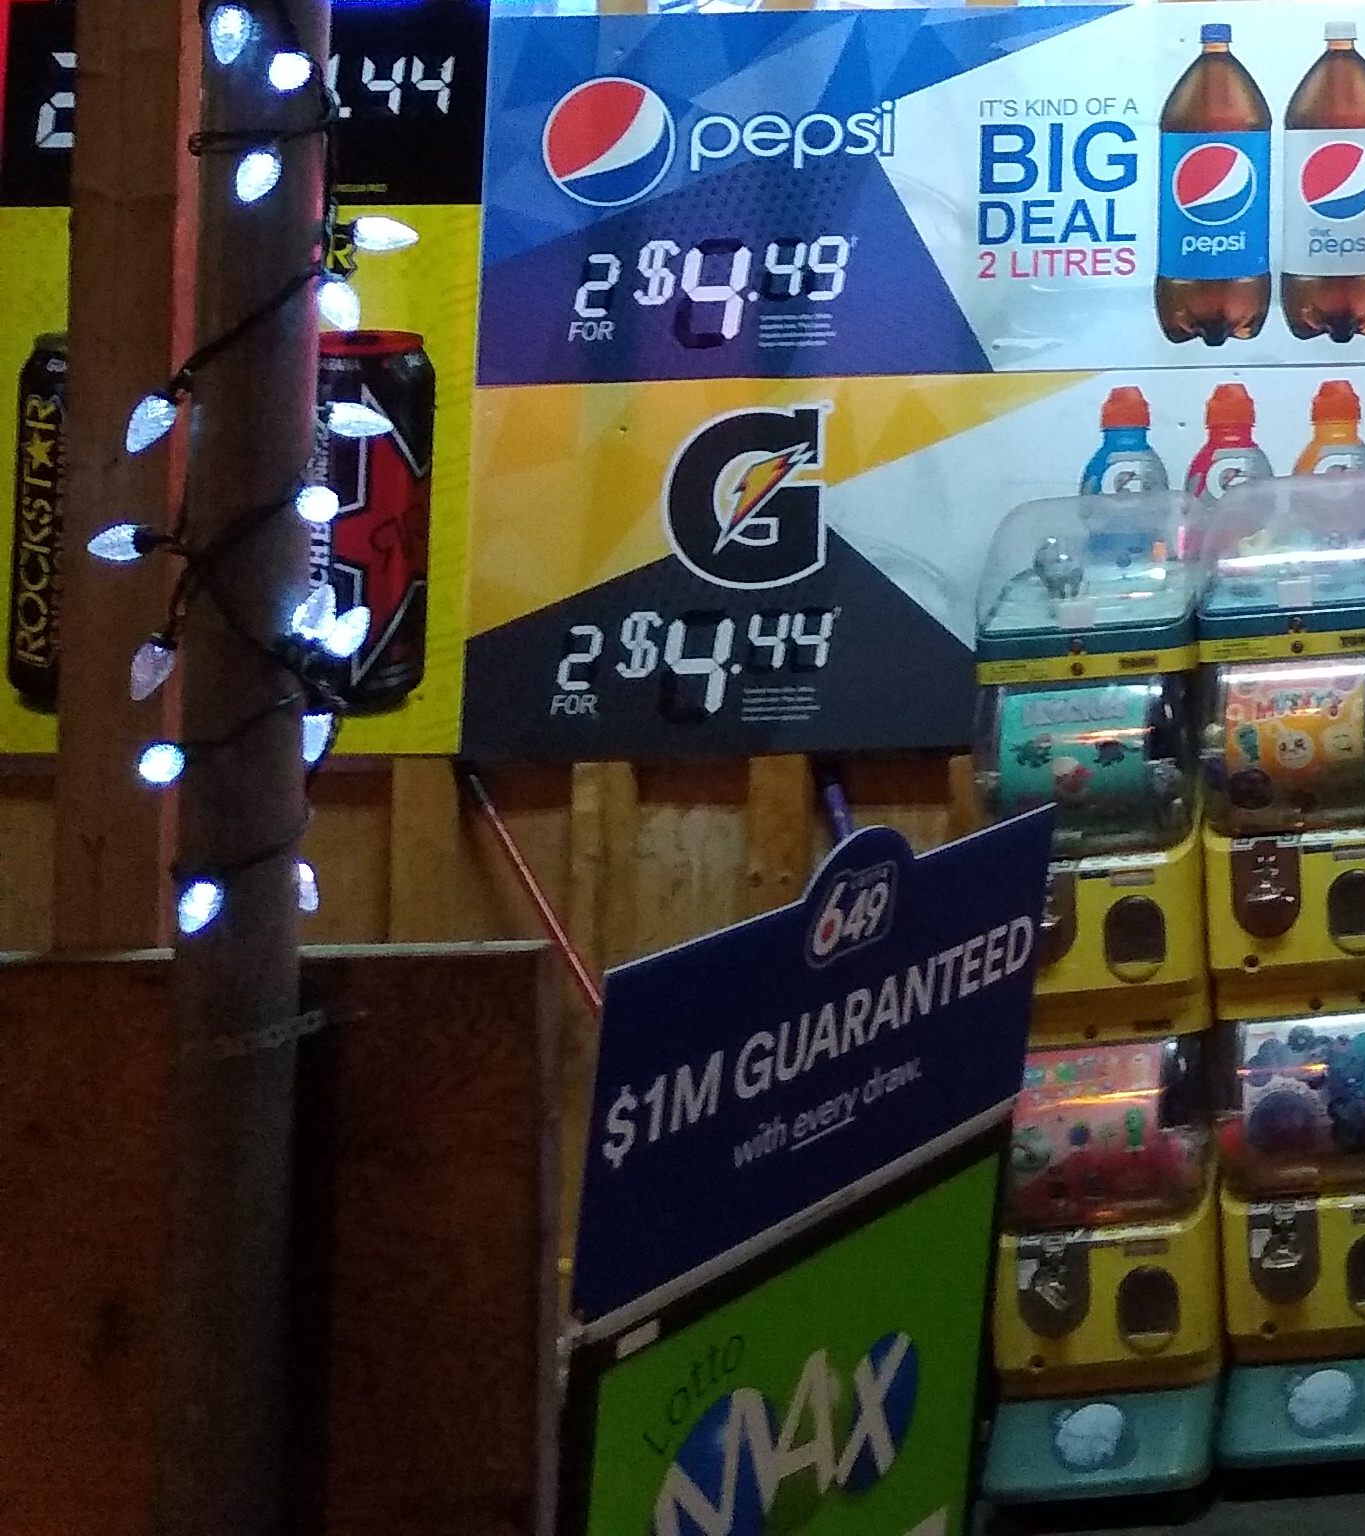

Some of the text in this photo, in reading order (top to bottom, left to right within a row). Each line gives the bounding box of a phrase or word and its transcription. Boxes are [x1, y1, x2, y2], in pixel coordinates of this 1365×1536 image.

[689, 100, 895, 172] pepsi
[978, 96, 1140, 119] IT'S KIND OF A
[978, 120, 1139, 195] BIG
[977, 198, 1137, 245] DEAL
[1181, 229, 1247, 256] pepsi
[573, 252, 622, 318] 2
[977, 247, 1137, 279] 2 LITRES
[567, 320, 615, 342] FOR
[556, 624, 605, 691] 2
[549, 694, 598, 716] FOR
[601, 915, 1035, 1169] $1M GUARANTEED
[732, 1114, 787, 1169] with
[792, 1084, 861, 1138] every
[641, 1334, 746, 1455] Lotto
[653, 1330, 913, 1536] MAX
